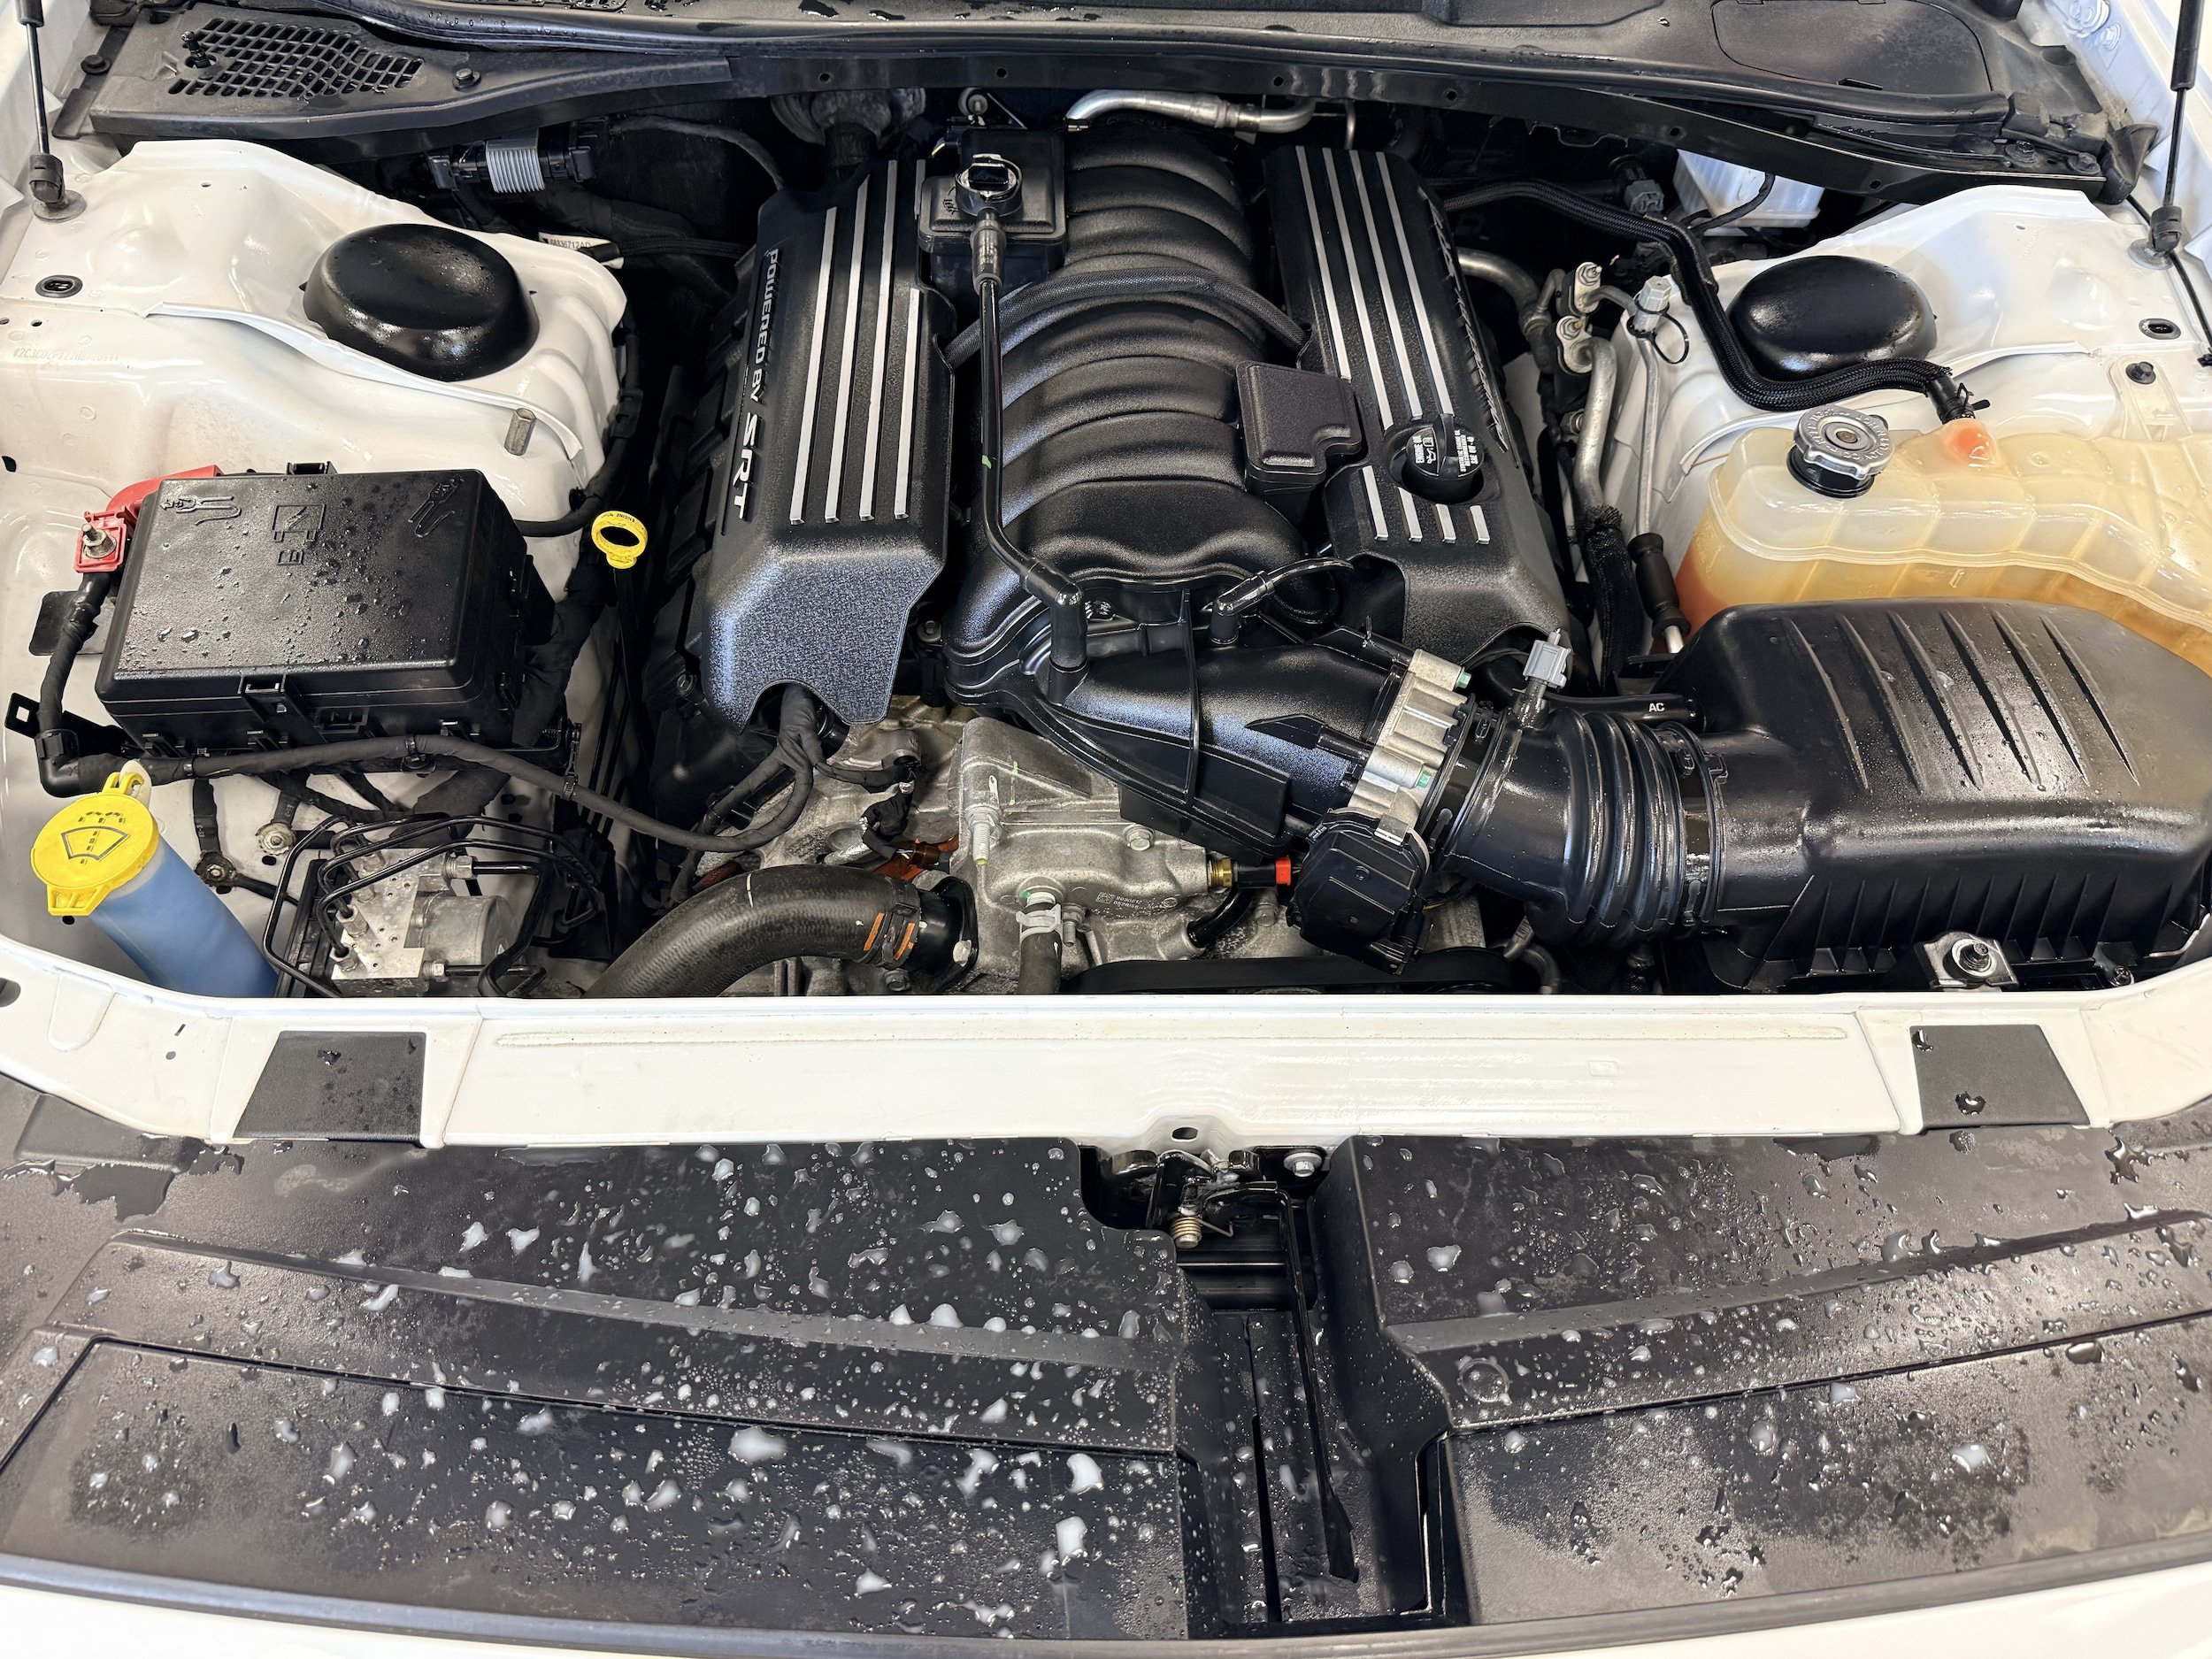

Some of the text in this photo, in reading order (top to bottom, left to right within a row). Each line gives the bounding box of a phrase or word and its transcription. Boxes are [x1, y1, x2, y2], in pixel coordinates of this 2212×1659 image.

[732, 248, 780, 519] POWERED BY SRT
[1412, 434, 1425, 464] ENGINE OIL
[1469, 454, 1479, 465] SAE
[616, 513, 635, 523] ENGINE
[1648, 702, 1665, 712] AC
